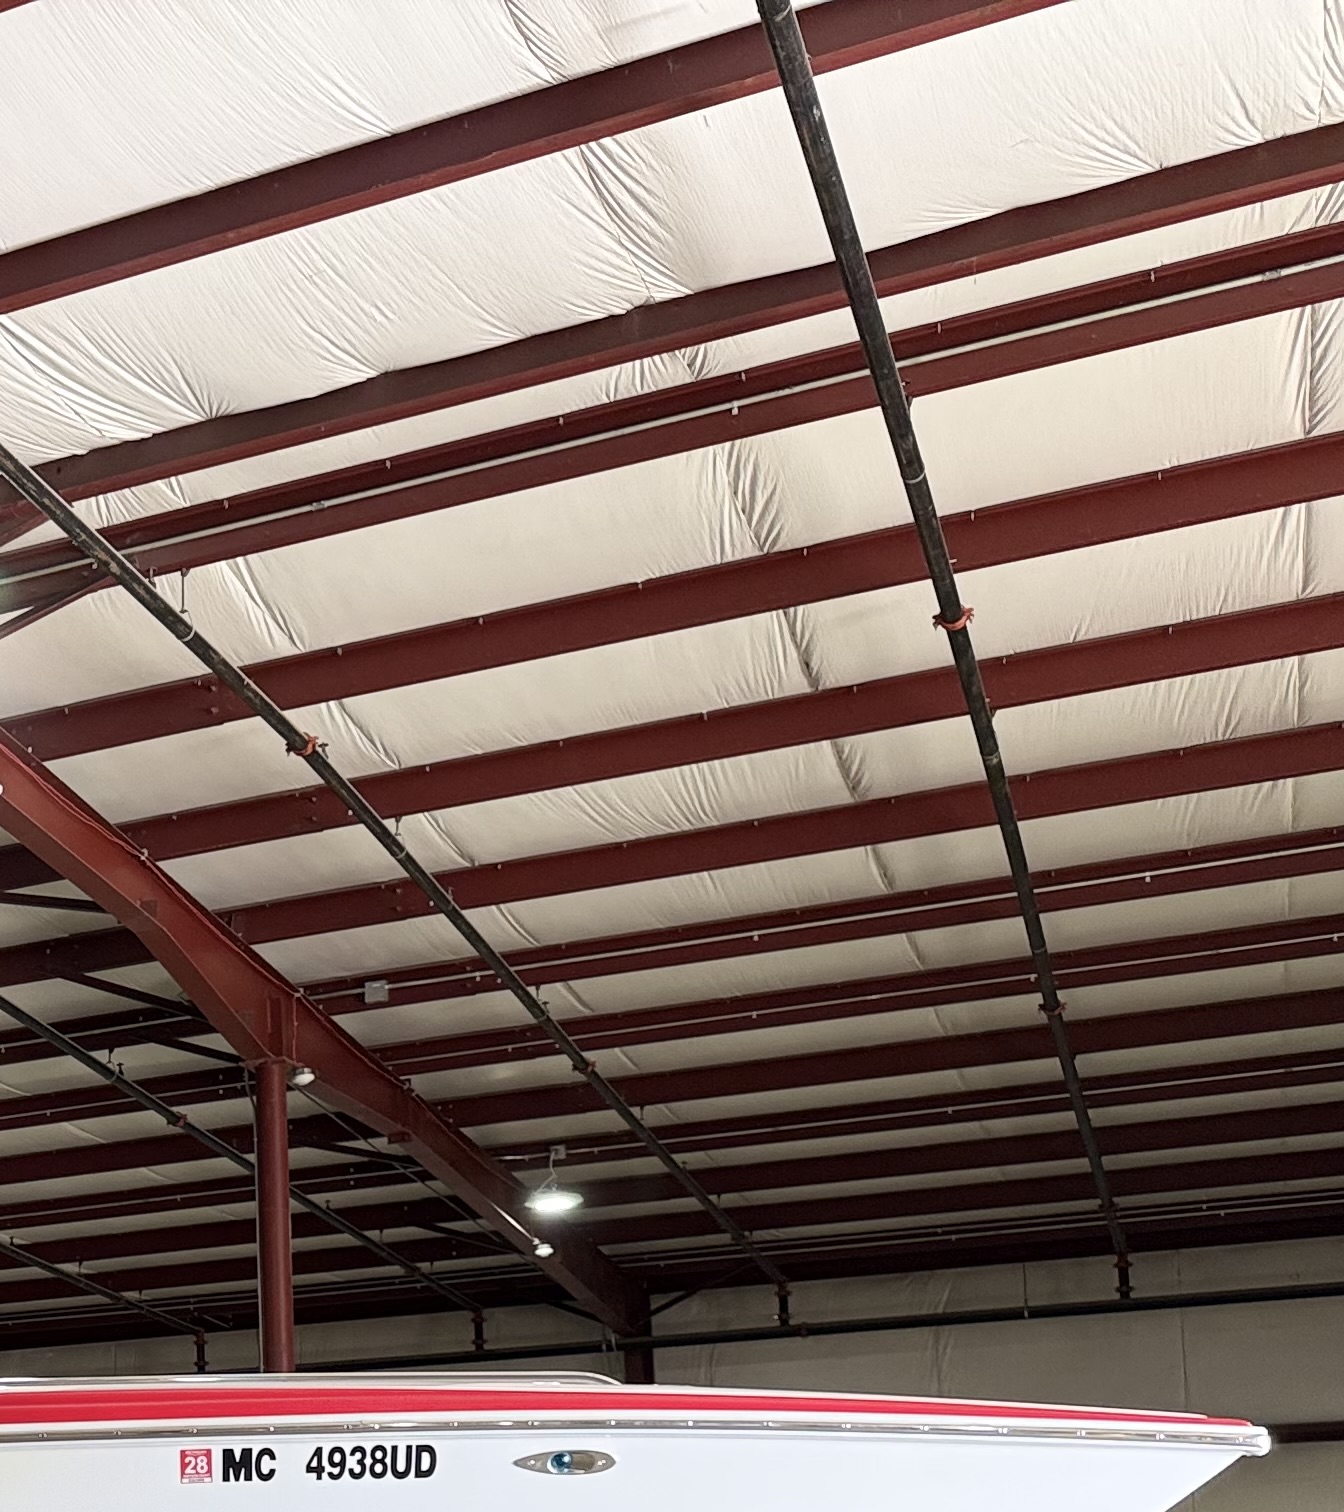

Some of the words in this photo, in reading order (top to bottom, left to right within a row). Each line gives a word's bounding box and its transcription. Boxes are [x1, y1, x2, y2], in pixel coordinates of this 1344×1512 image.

[184, 1455, 209, 1475] 28
[222, 1448, 276, 1482] MC
[305, 1444, 437, 1480] 4938UD
